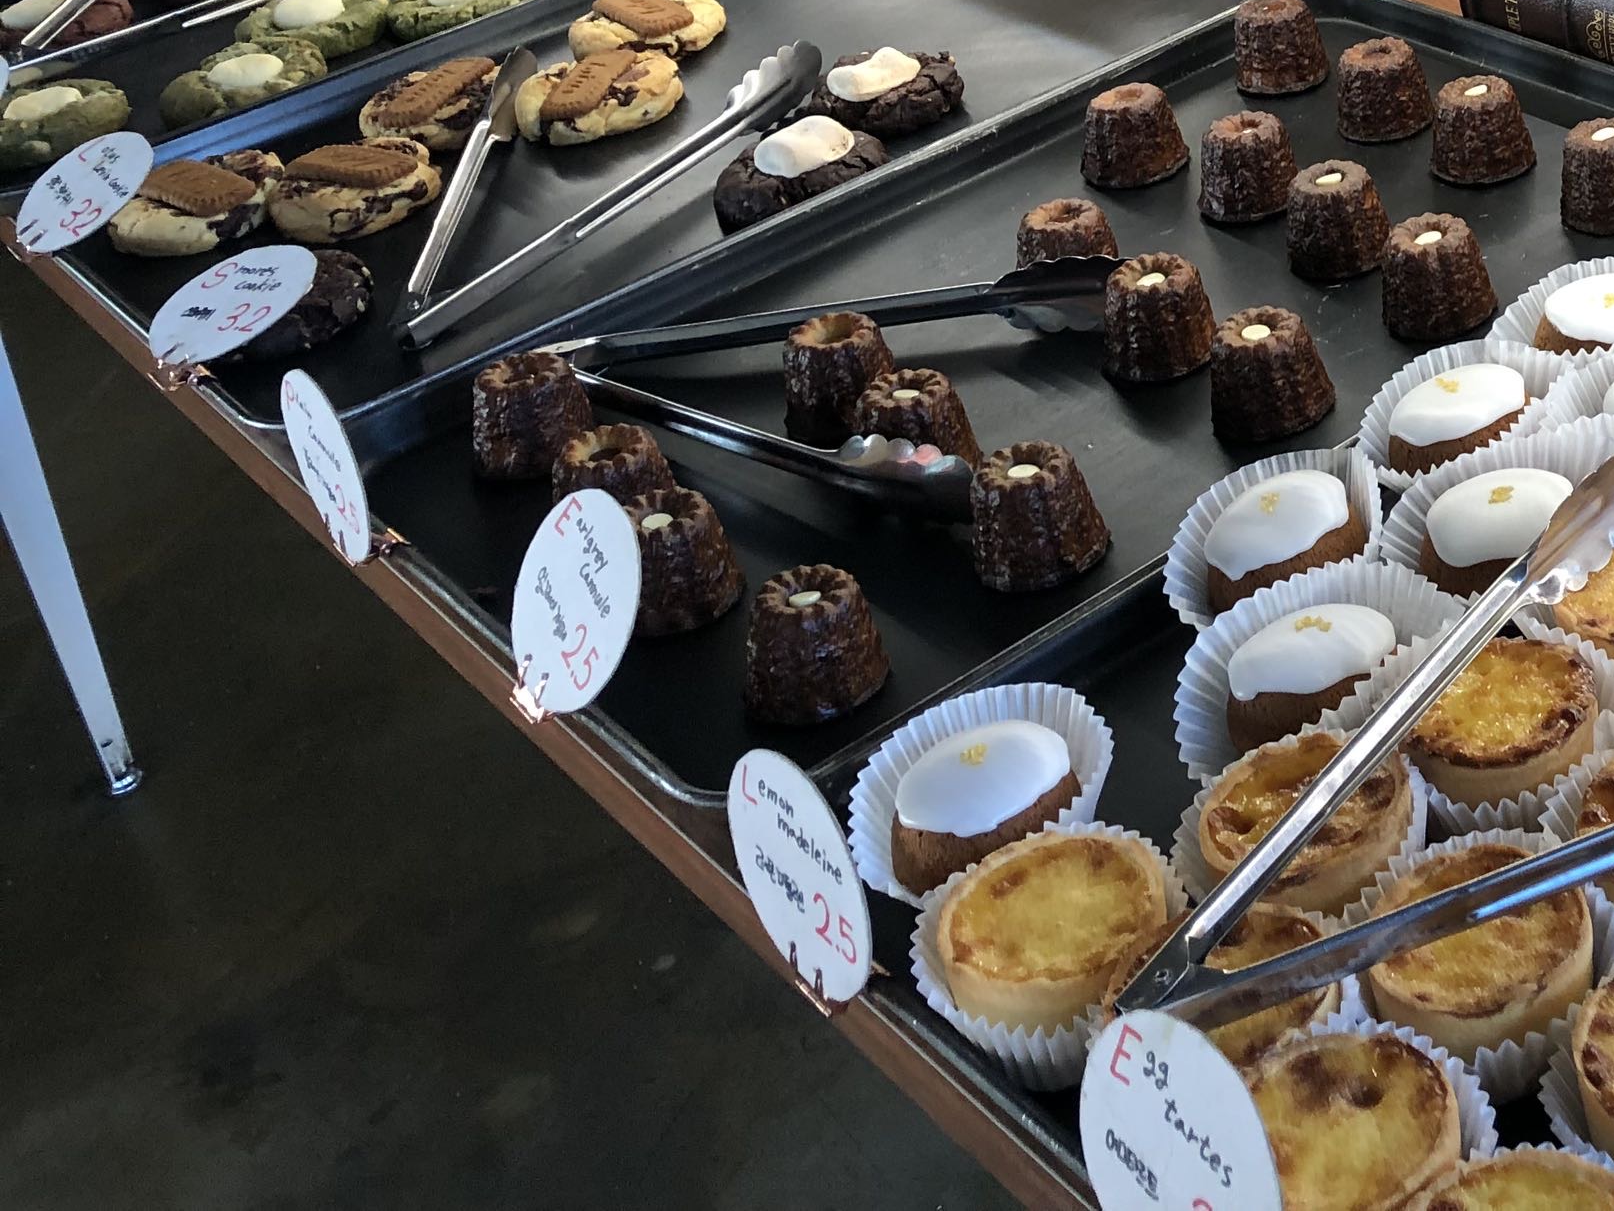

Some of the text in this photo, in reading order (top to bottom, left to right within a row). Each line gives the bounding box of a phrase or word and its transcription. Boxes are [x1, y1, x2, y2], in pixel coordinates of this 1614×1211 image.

[201, 262, 279, 290] Smores
[234, 279, 282, 293] cookie
[217, 302, 272, 333] 3.2
[561, 623, 599, 690] 2.5
[741, 764, 794, 818] Lemon
[777, 811, 843, 885] madeleine
[813, 892, 857, 964] 2.5
[1109, 1023, 1169, 1090] Egg
[1164, 1097, 1233, 1189] tartes
